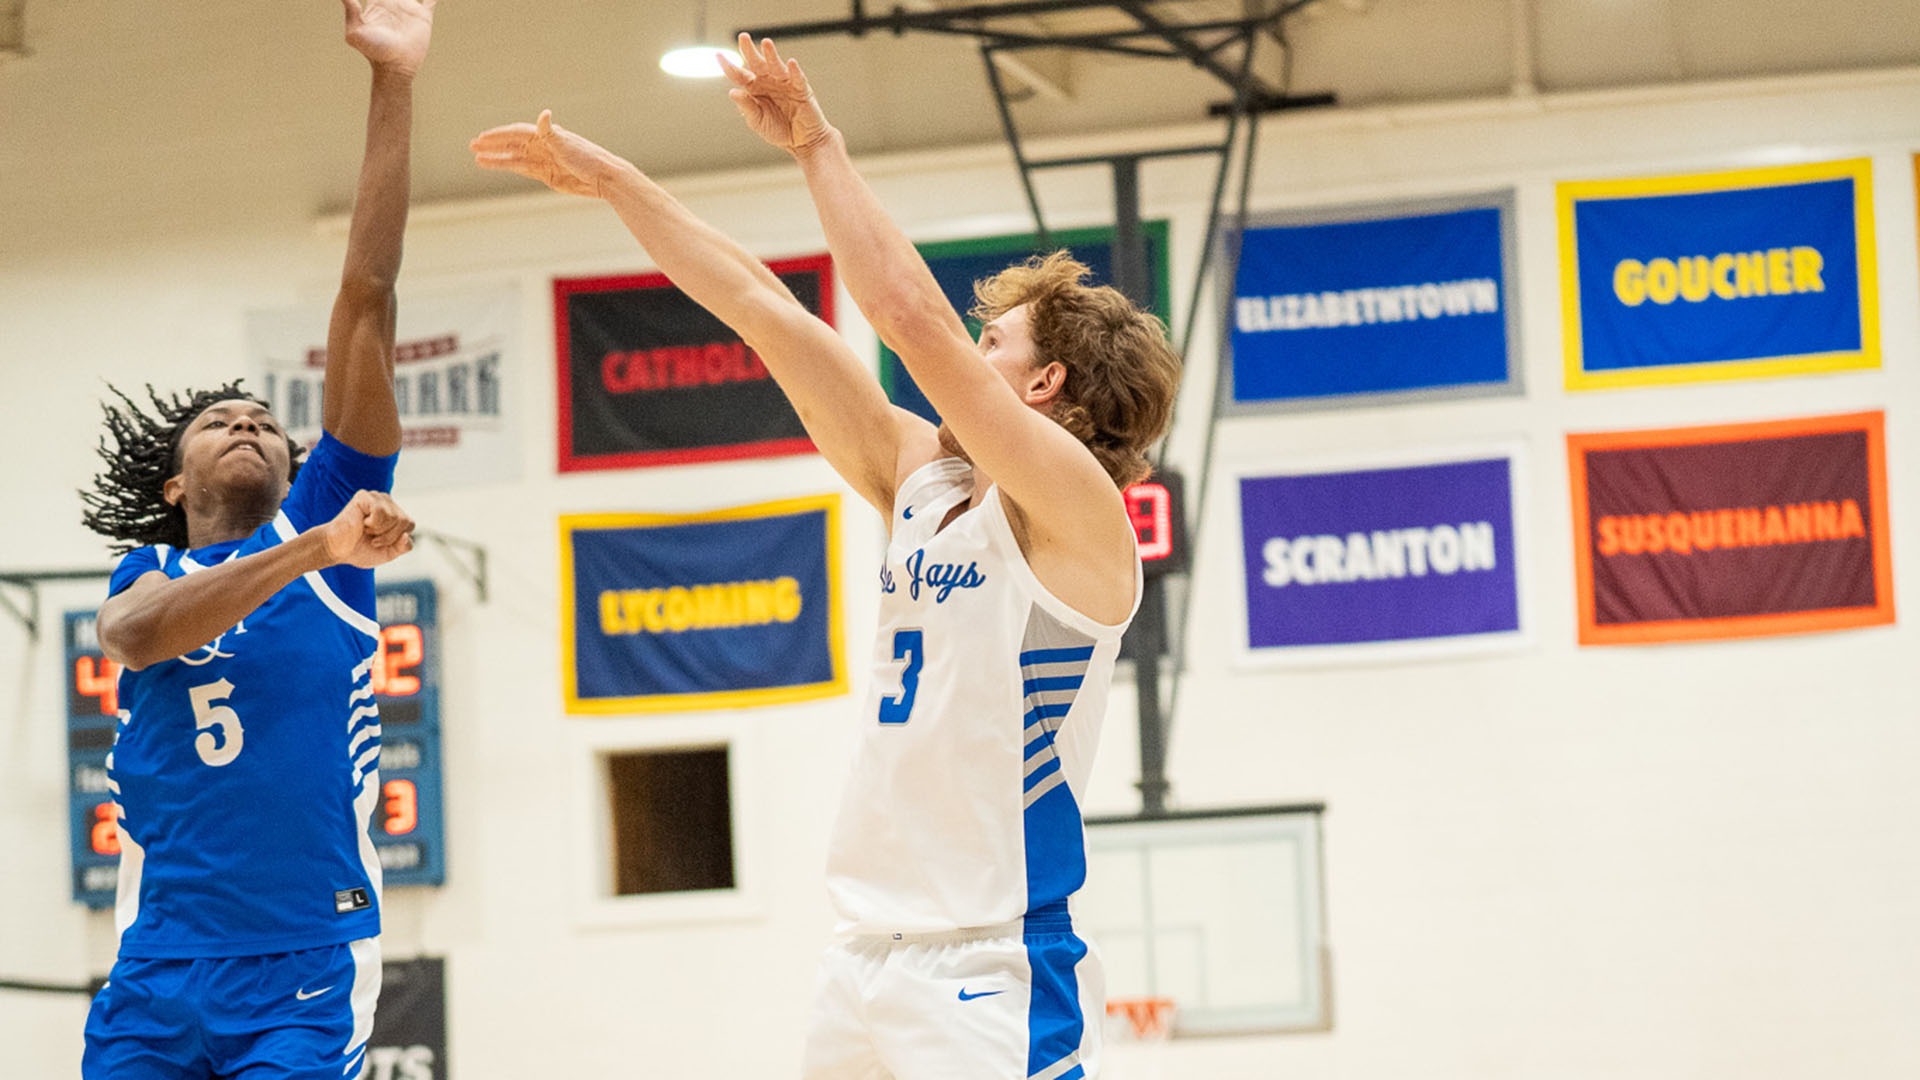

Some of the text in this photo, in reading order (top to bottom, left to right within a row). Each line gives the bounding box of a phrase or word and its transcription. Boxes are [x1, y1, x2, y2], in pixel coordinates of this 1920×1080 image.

[1235, 277, 1499, 333] ELIZABETHTOWN
[1613, 246, 1825, 307] GOUCHER
[1262, 522, 1496, 587] SCRANTON
[1598, 499, 1866, 556] SUSQUEHANNA
[906, 548, 986, 604] Jays
[600, 577, 802, 635] LYCOMING
[878, 628, 924, 726] 3
[188, 677, 245, 767] 5
[383, 779, 417, 836] 3
